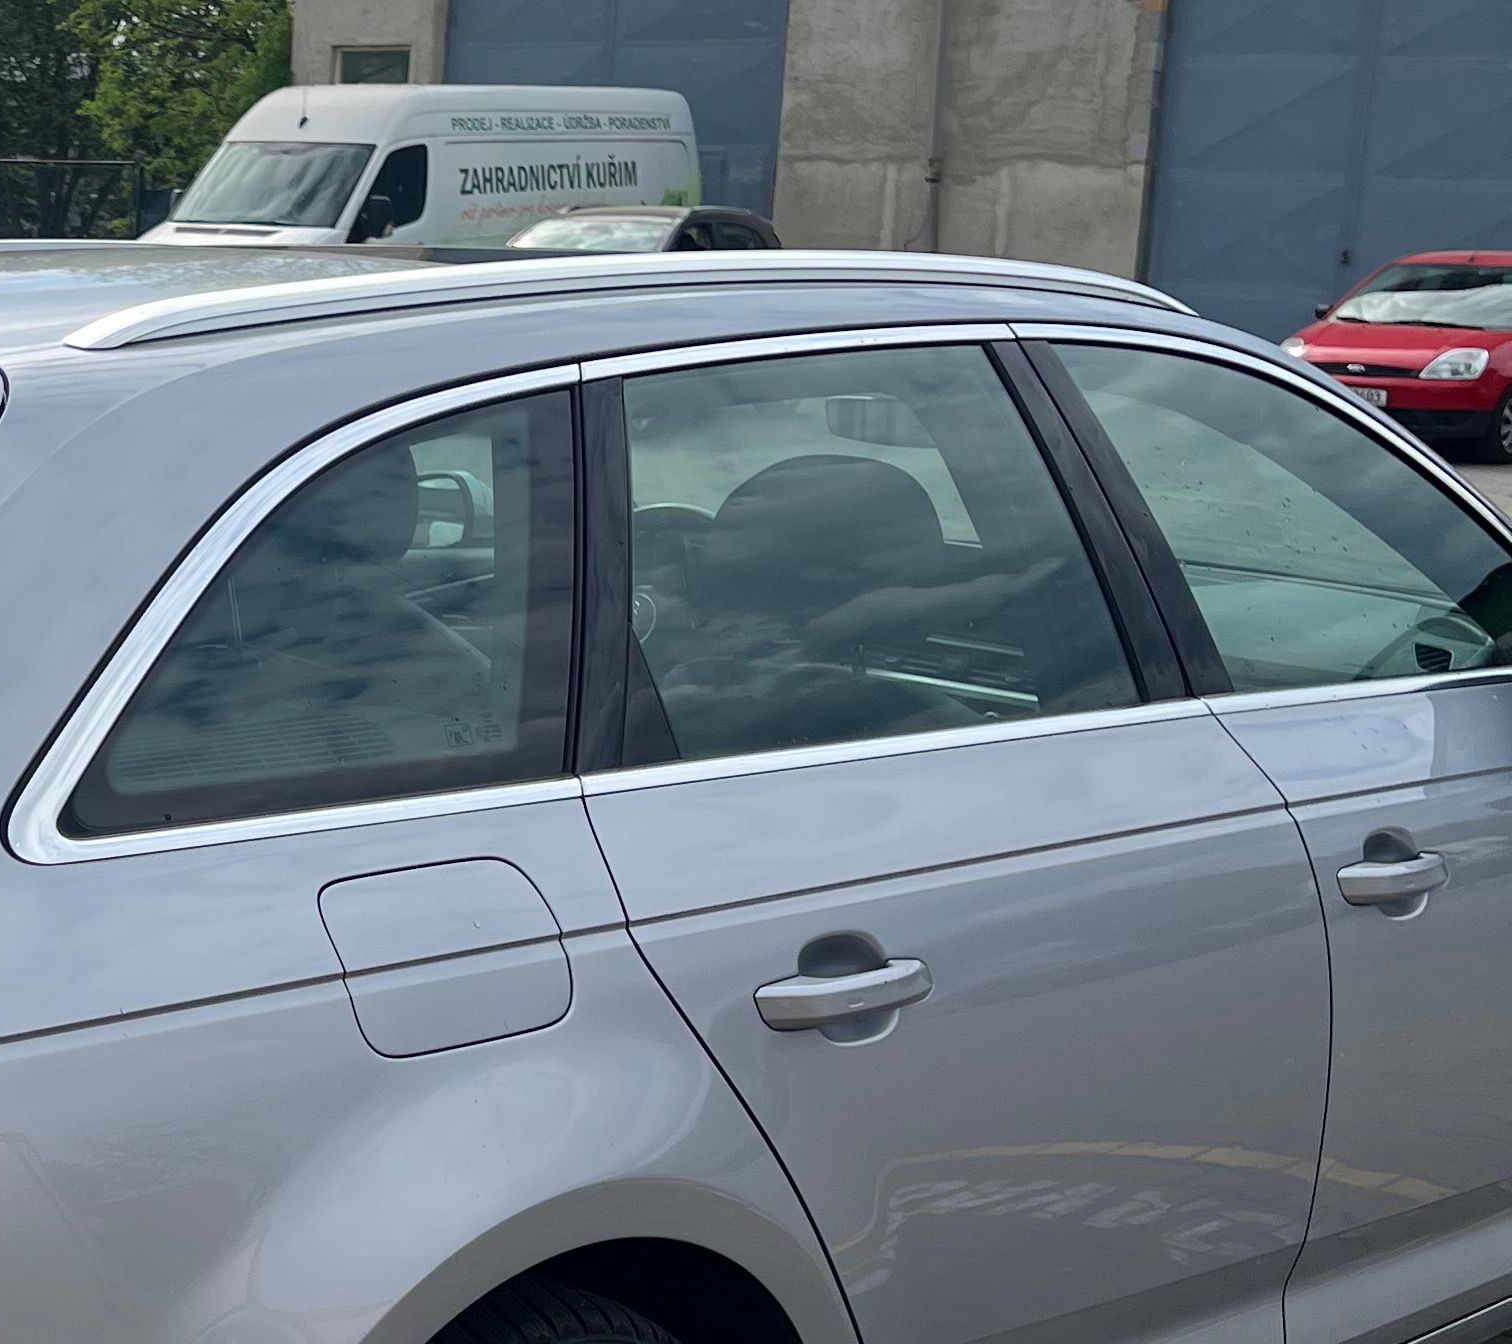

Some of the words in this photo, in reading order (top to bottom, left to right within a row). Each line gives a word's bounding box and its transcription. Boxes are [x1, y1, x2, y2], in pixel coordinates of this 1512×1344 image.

[451, 117, 492, 131] PRODEJ
[459, 155, 581, 196] ZAHRADNICTVÍ
[585, 154, 638, 189] KUŘIM
